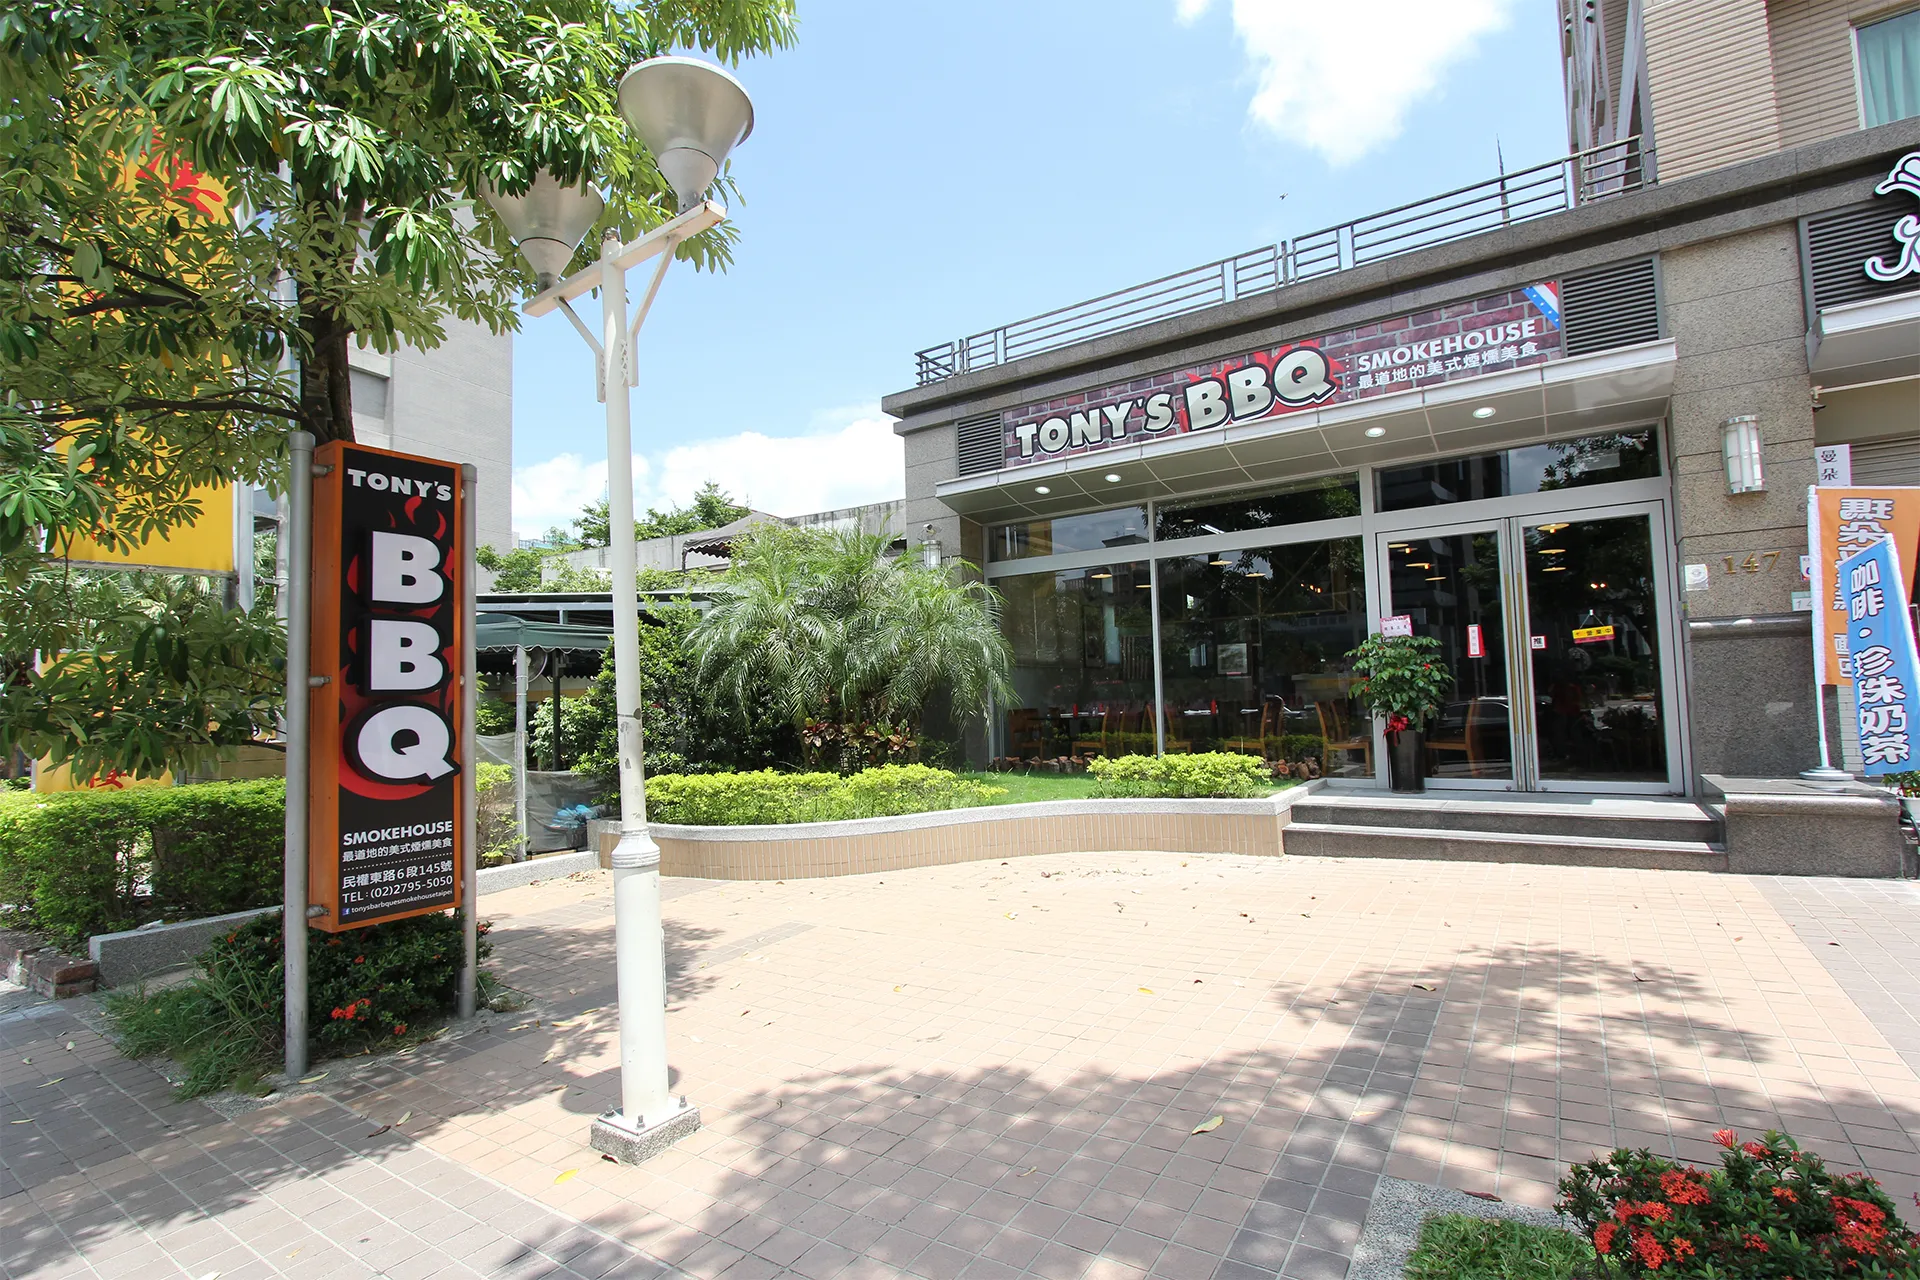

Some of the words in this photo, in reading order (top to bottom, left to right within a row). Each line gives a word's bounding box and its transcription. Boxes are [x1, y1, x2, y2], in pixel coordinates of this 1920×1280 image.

[1358, 319, 1536, 373] SMOKEHOUSE
[1358, 341, 1539, 390] 最道地的美式煙燻美食
[1015, 393, 1173, 458] TONY'S
[1184, 348, 1333, 430] BBQ
[347, 468, 452, 501] TONY'S
[1721, 550, 1781, 575] 147
[358, 531, 454, 780] BBQ
[343, 820, 453, 846] SMOKEHOUSE
[342, 837, 453, 863] 最道地的美式煙燻美食
[342, 859, 453, 890] 民權東路6段145號
